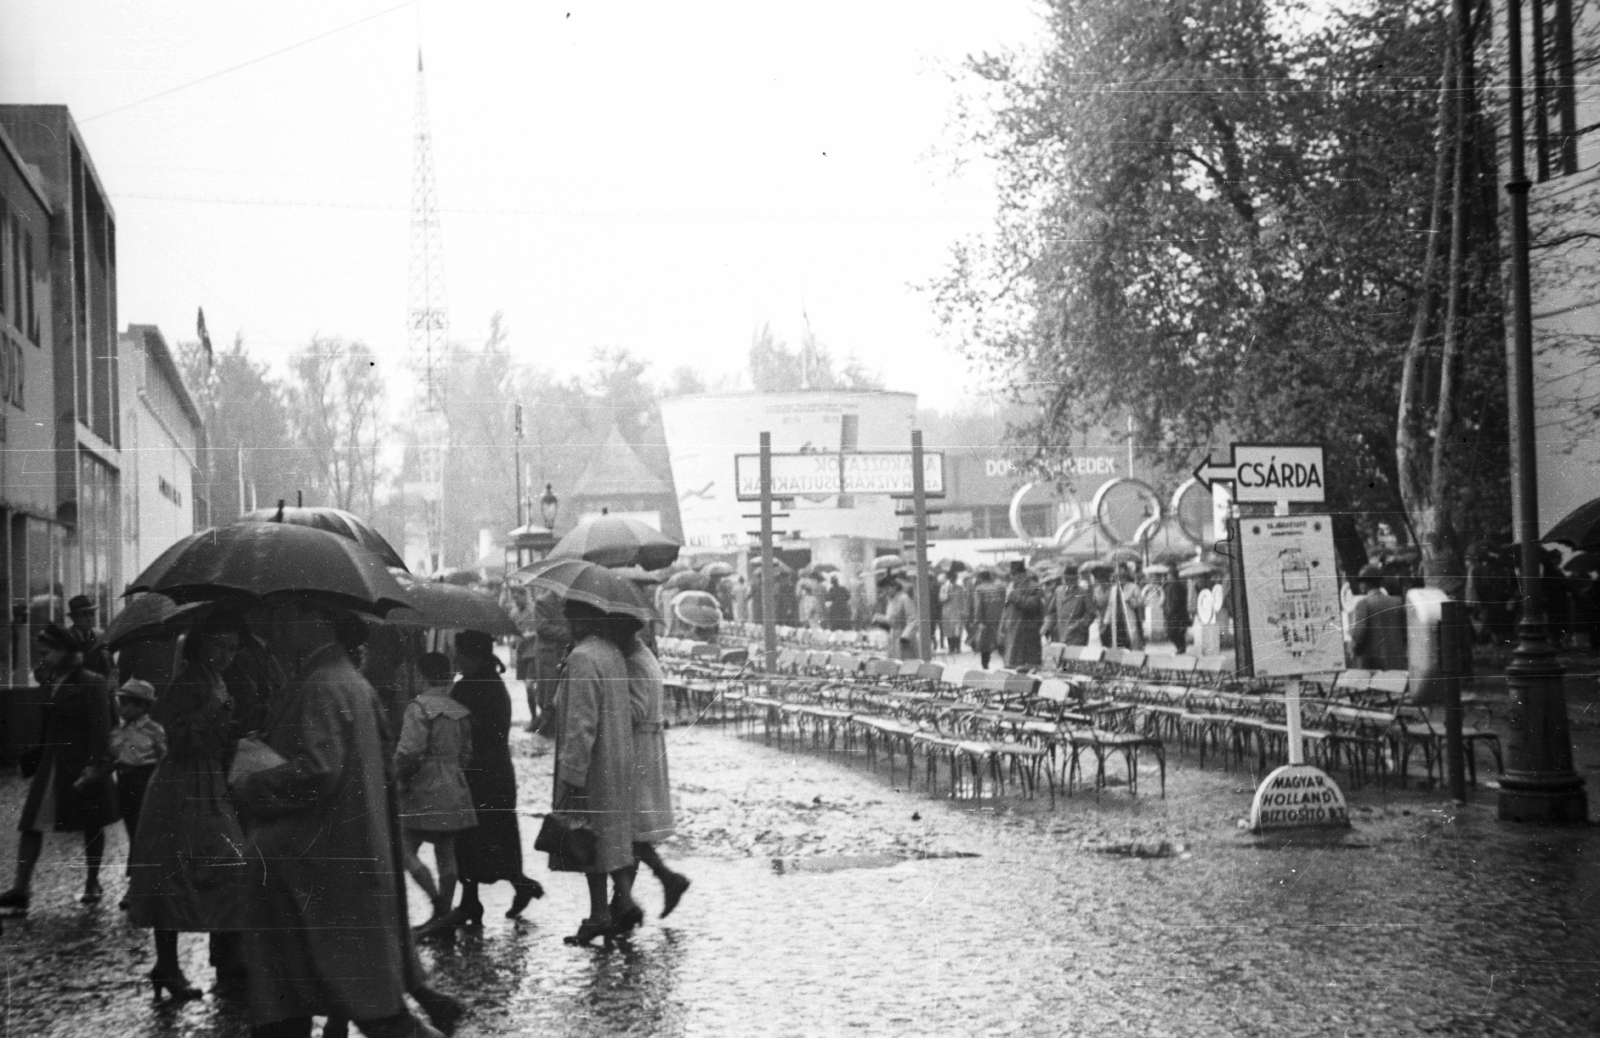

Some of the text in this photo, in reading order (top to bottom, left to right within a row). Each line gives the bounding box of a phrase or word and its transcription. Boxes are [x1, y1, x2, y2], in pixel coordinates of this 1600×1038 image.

[1237, 456, 1322, 488] CSÁRDA
[1271, 775, 1326, 790] MAGYAR
[1262, 787, 1339, 807] HOLLANDI
